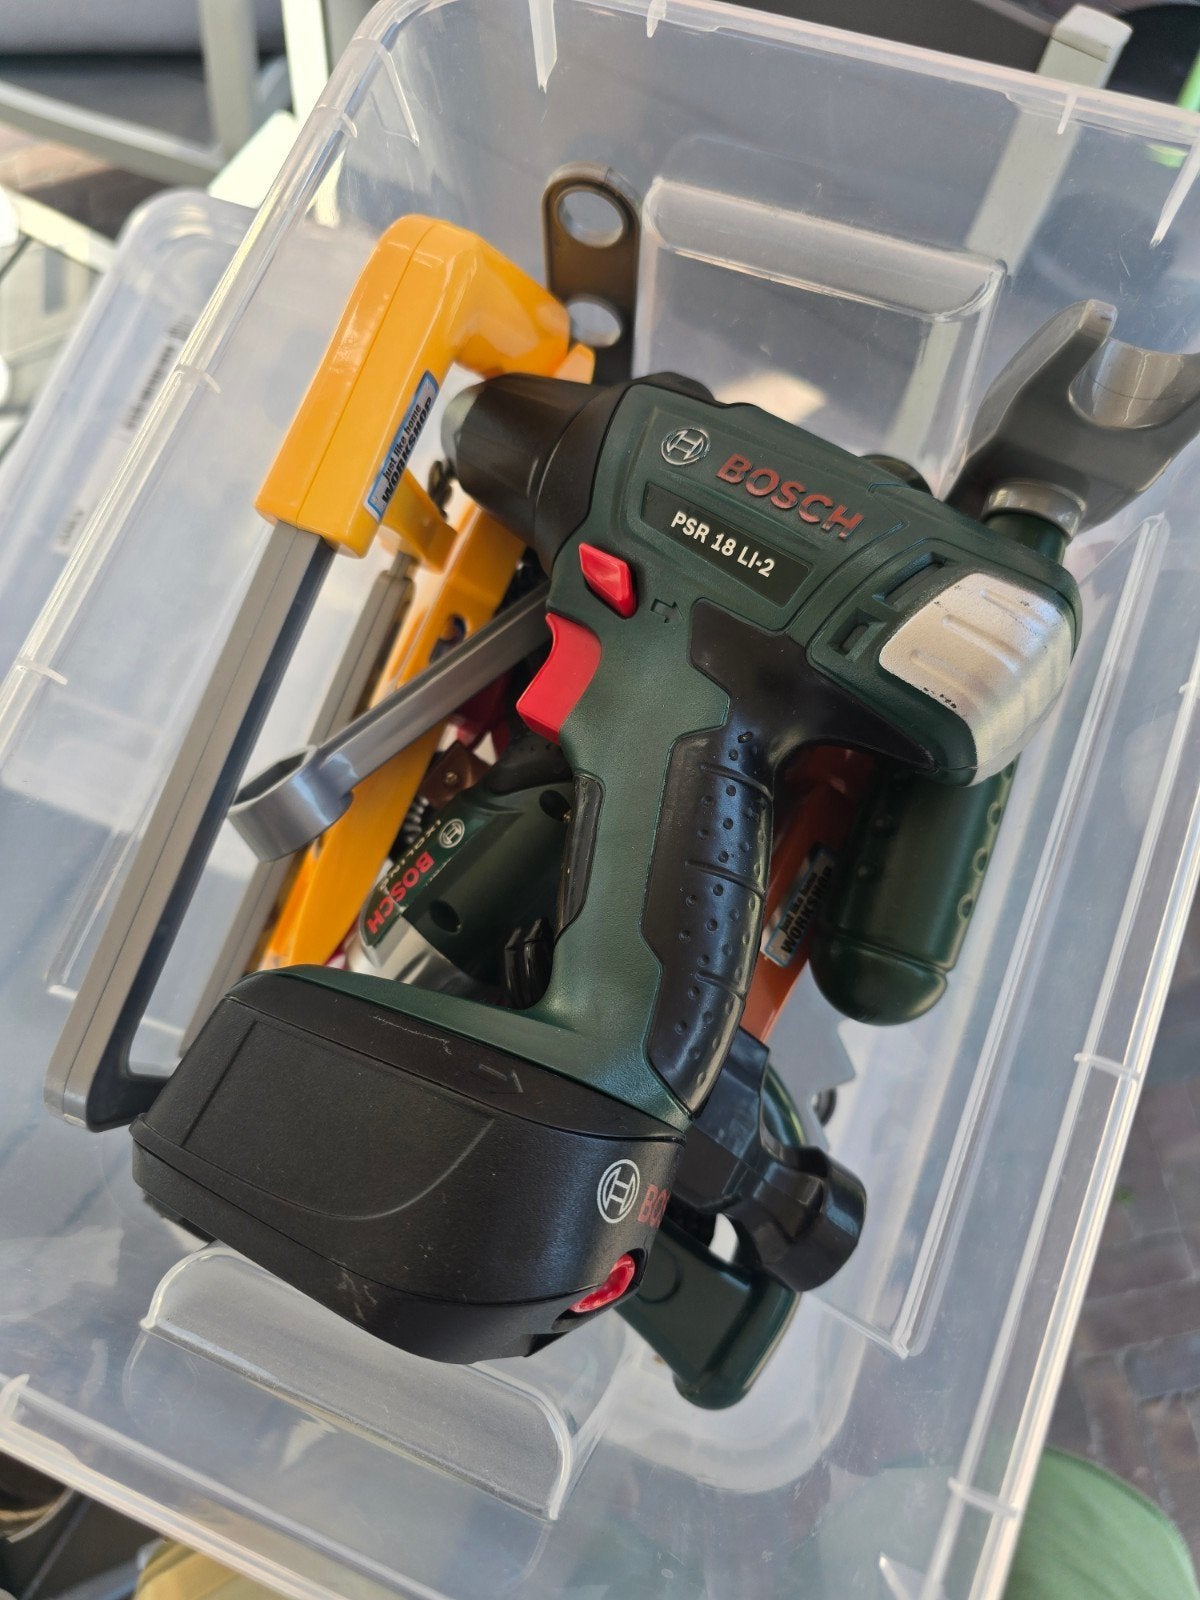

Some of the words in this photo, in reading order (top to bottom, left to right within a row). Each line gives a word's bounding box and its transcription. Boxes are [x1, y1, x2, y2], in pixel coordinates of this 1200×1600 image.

[381, 397, 432, 504] WORKSHOP
[382, 456, 397, 481] just
[393, 436, 407, 456] like
[404, 404, 422, 435] home
[715, 453, 863, 540] BOSCH
[670, 510, 710, 544] PSR
[710, 531, 737, 557] 18
[737, 545, 776, 578] LI-2
[367, 851, 435, 934] BOSCH
[637, 1183, 671, 1229] BO
